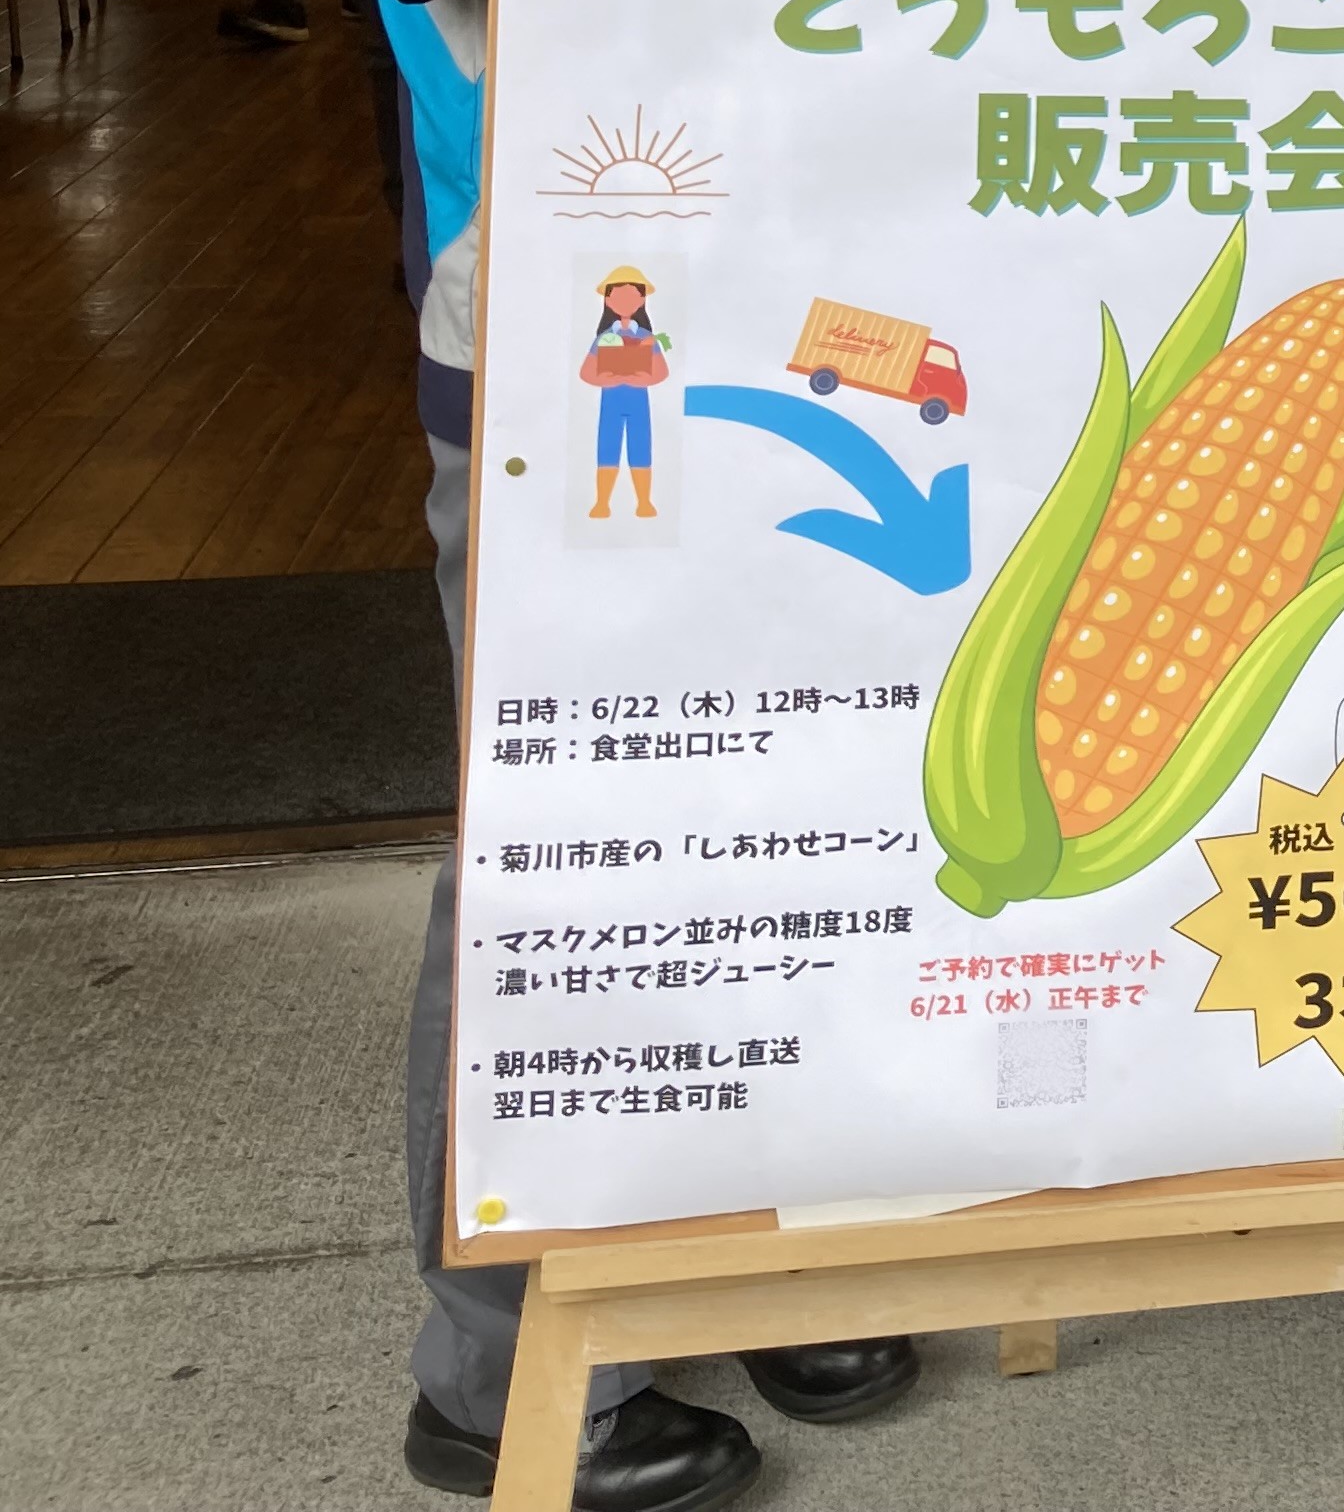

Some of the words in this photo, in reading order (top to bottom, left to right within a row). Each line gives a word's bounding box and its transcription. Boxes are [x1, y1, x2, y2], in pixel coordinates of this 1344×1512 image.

[827, 324, 899, 356] delivery
[492, 730, 774, 765] 場所：食堂出口にて
[1269, 823, 1335, 855] 税込
[495, 955, 836, 996] 濃い甘さで超ジューシー
[919, 948, 1167, 982] ご予約で確実にゲット
[910, 985, 1149, 1020] 6/21（水）正午まで
[493, 1082, 749, 1120] 翌日まで生食可能
